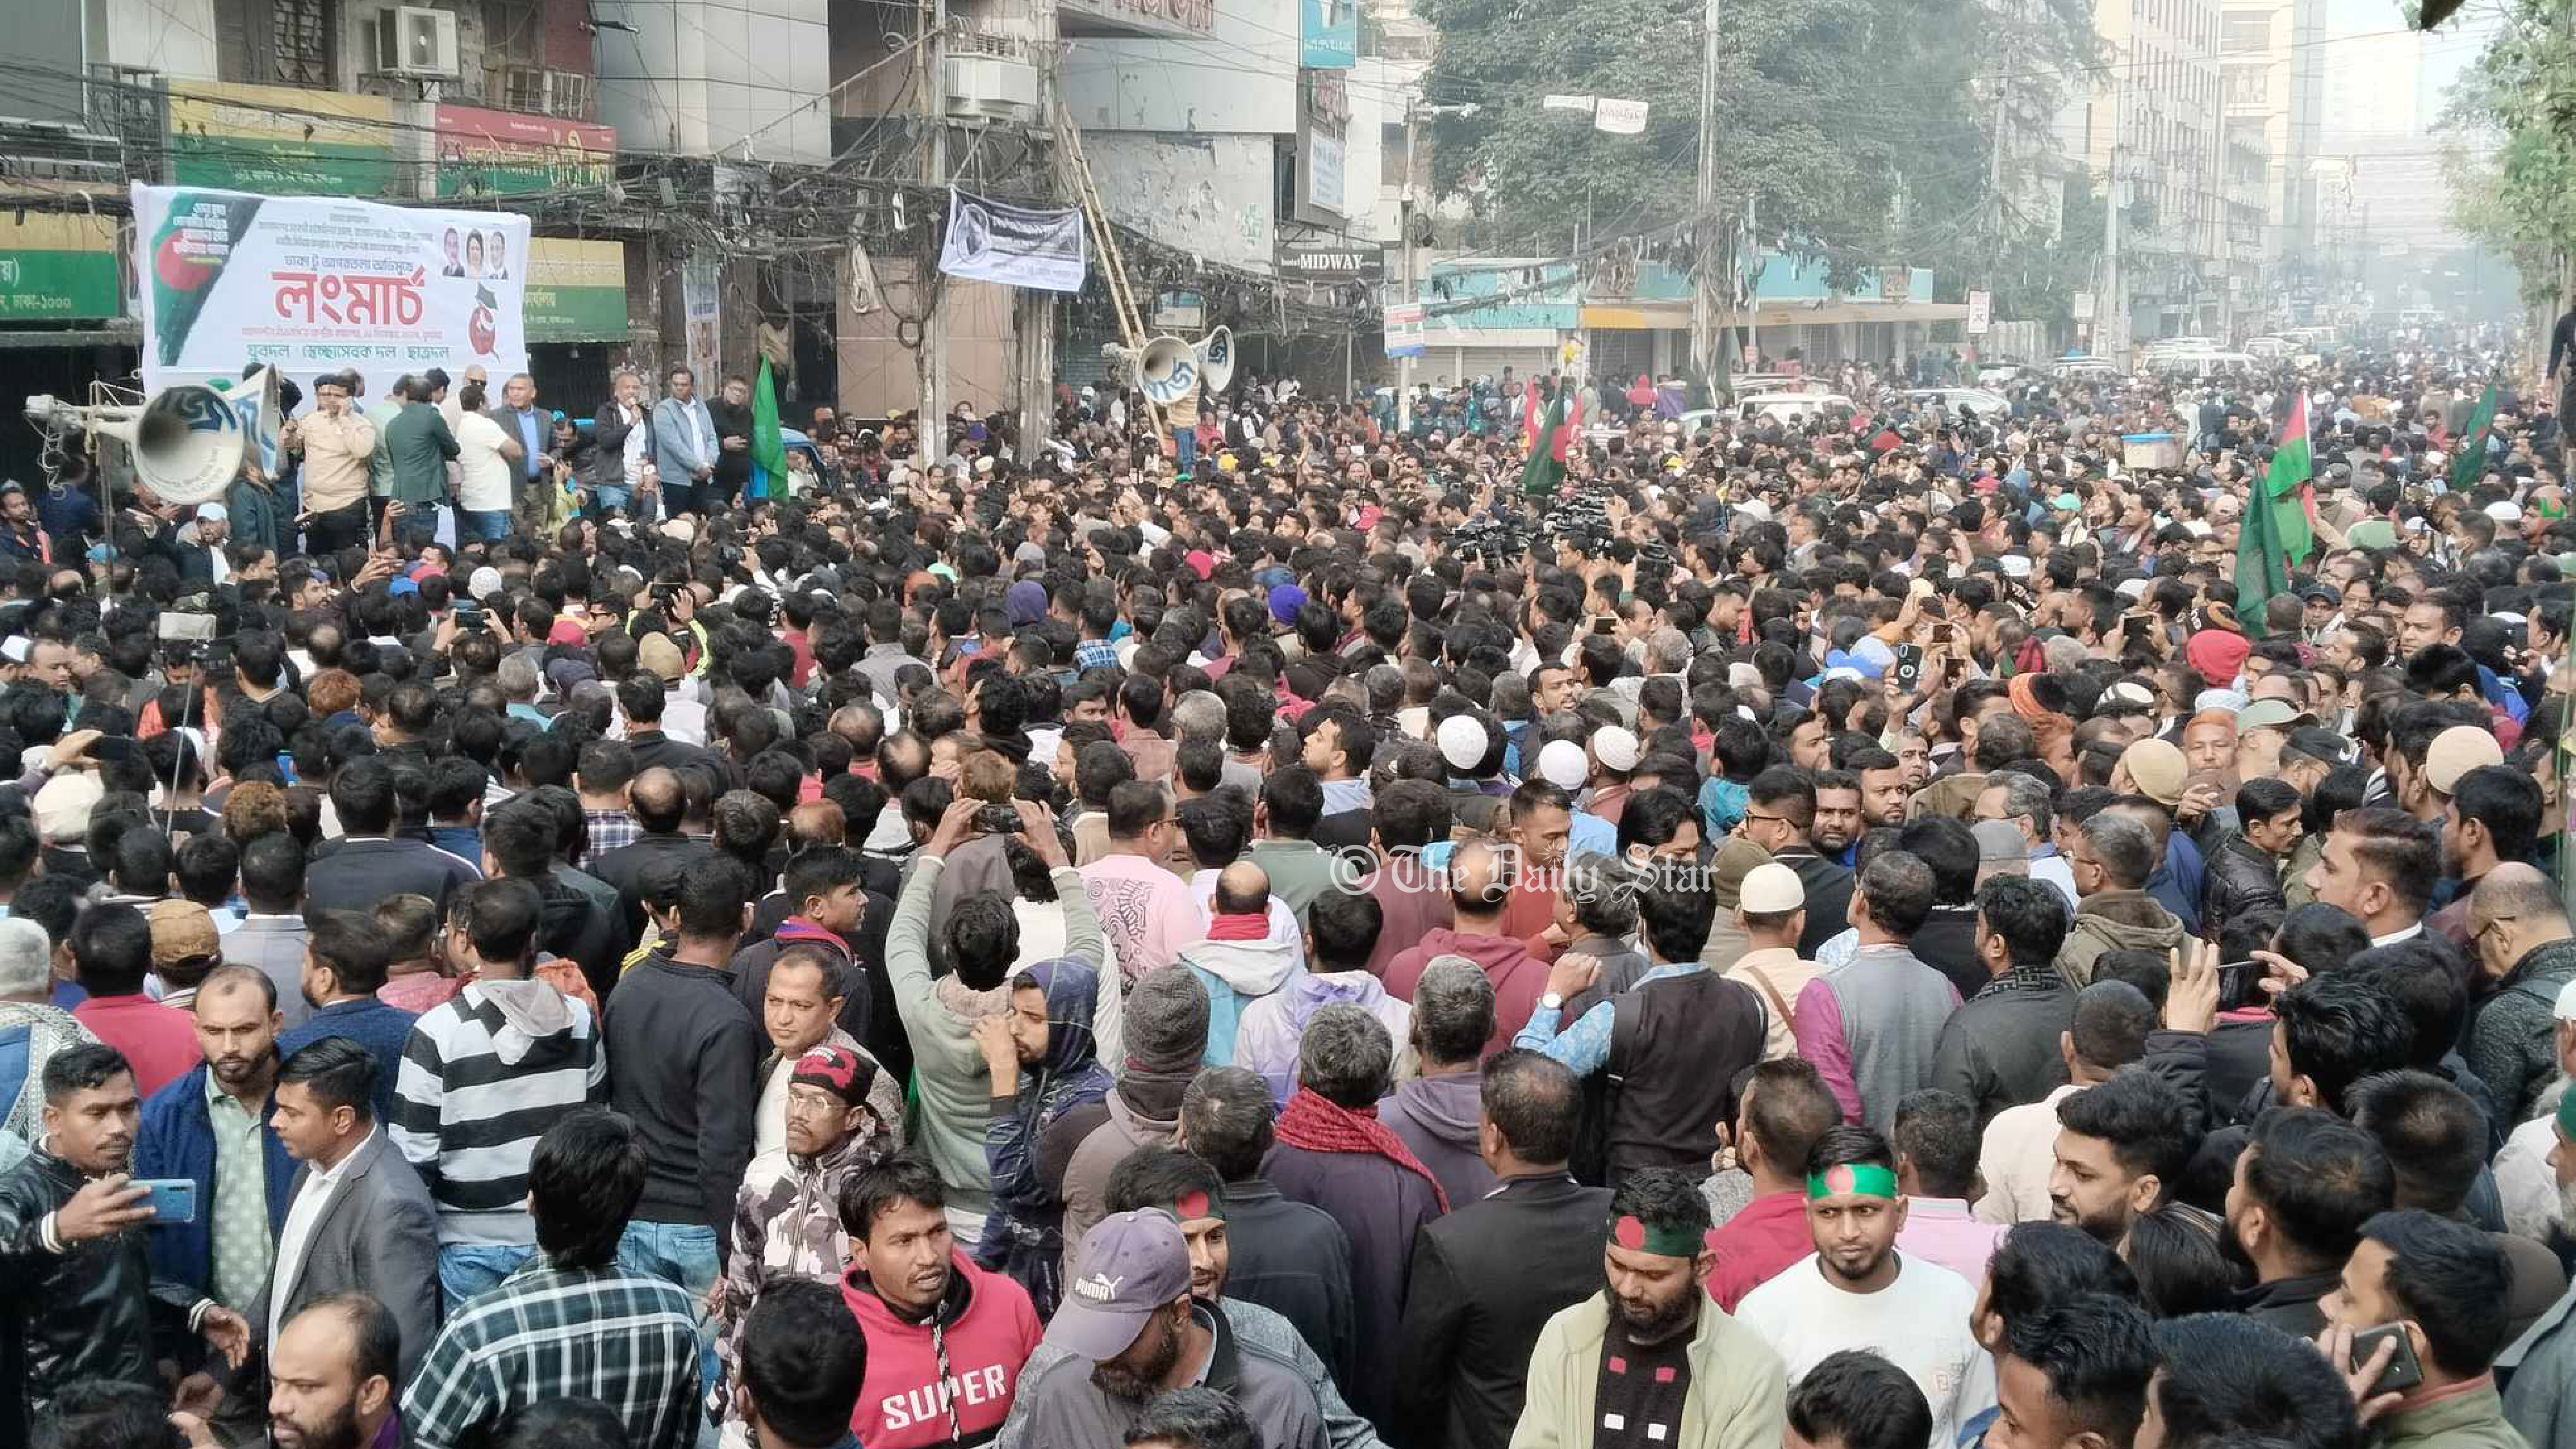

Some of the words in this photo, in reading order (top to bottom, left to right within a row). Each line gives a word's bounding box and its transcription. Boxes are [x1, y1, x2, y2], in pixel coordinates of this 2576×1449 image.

[1300, 254, 1363, 269] MIDWAY
[272, 264, 424, 325] লংমার্চ
[247, 344, 290, 361] যুবদল
[375, 345, 397, 356] দল
[406, 345, 450, 360] ছাত্রদল
[1075, 1277, 1110, 1302] PUMA
[881, 1364, 1007, 1430] SUPER
